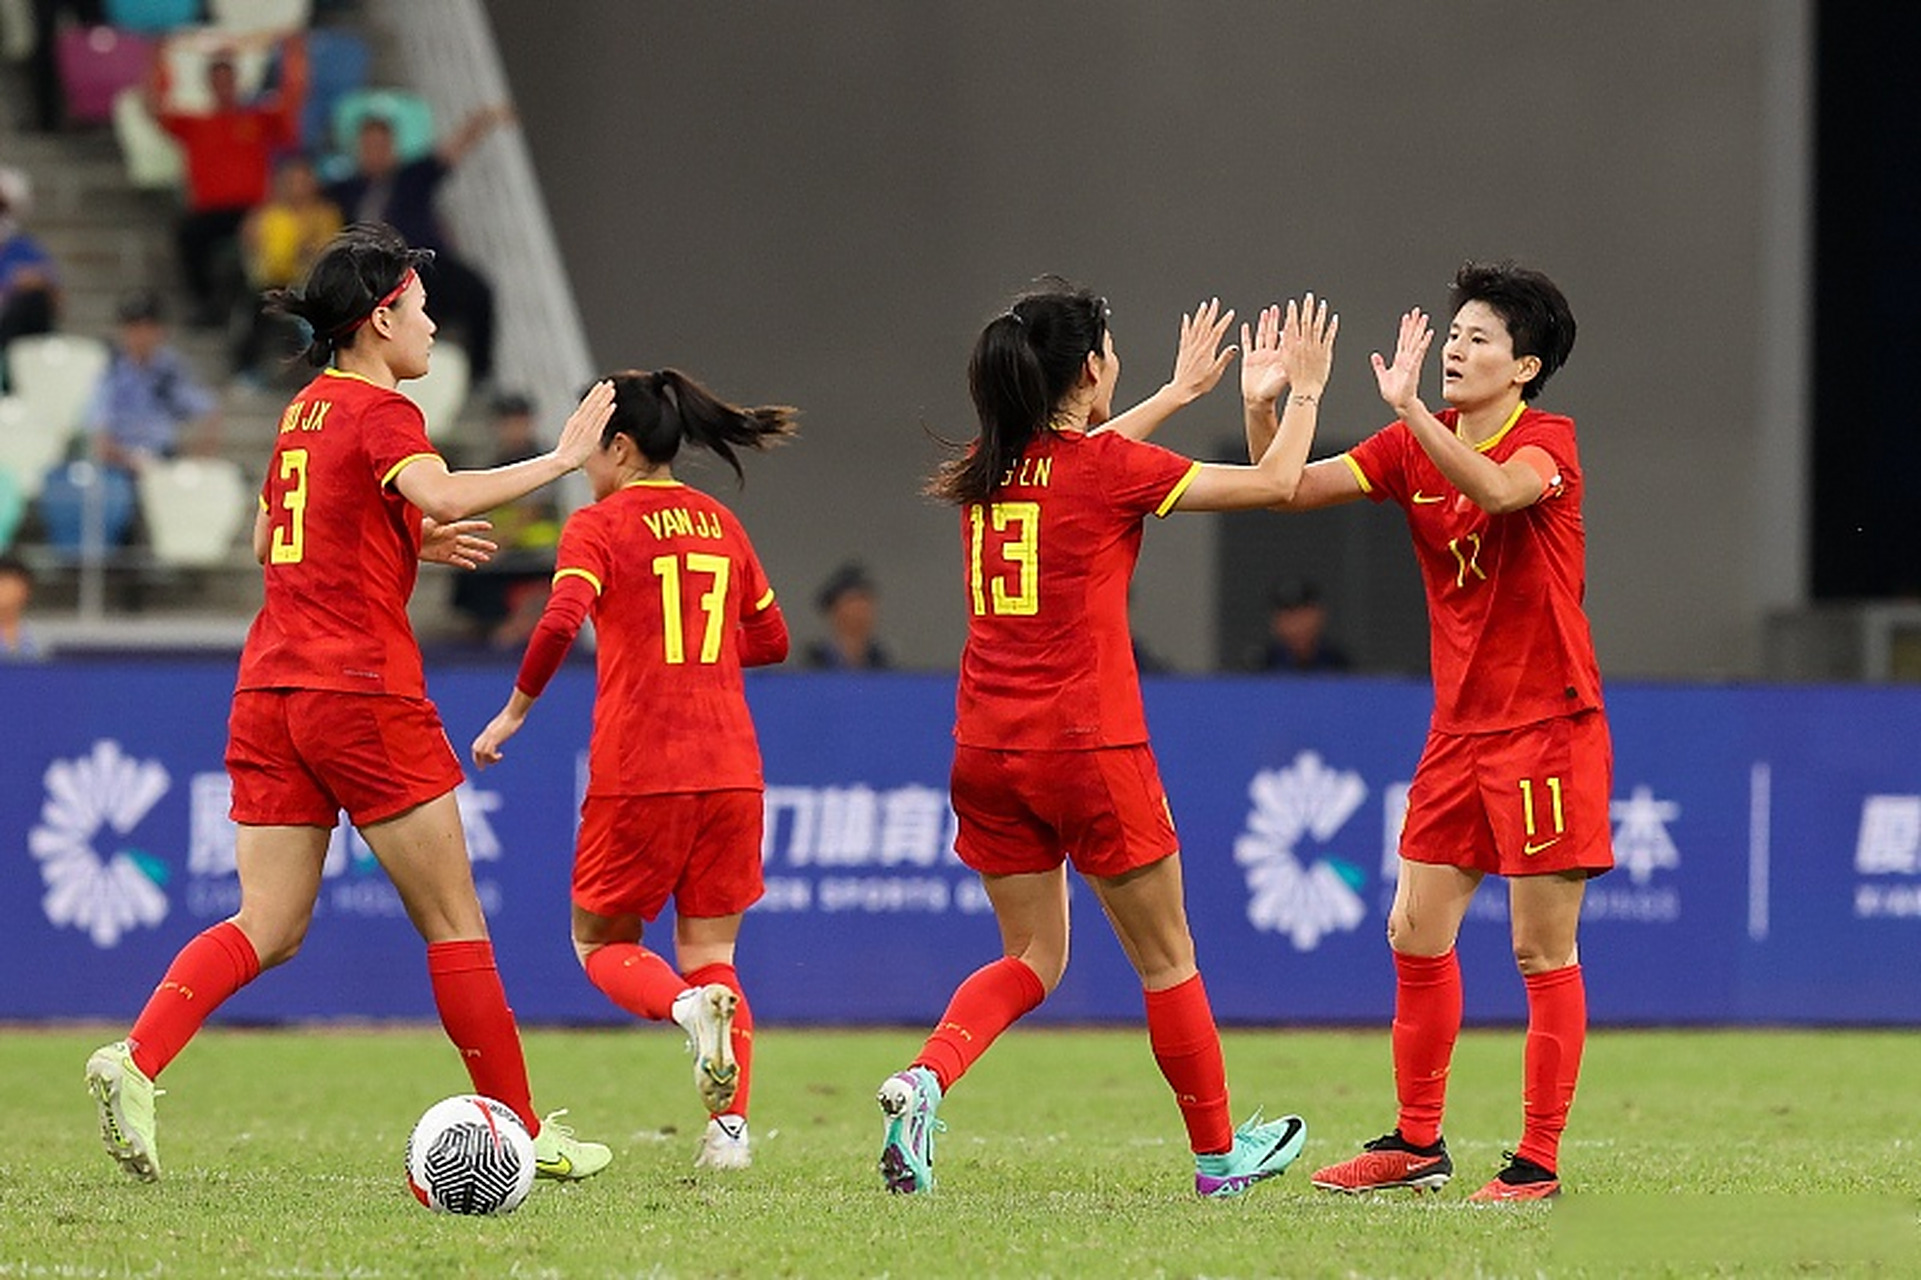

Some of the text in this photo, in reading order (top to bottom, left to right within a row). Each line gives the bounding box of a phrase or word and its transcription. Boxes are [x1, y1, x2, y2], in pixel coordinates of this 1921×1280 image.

[271, 449, 308, 565] 3
[971, 502, 1040, 615] 13
[653, 553, 730, 663] 17
[1519, 777, 1564, 835] 11
